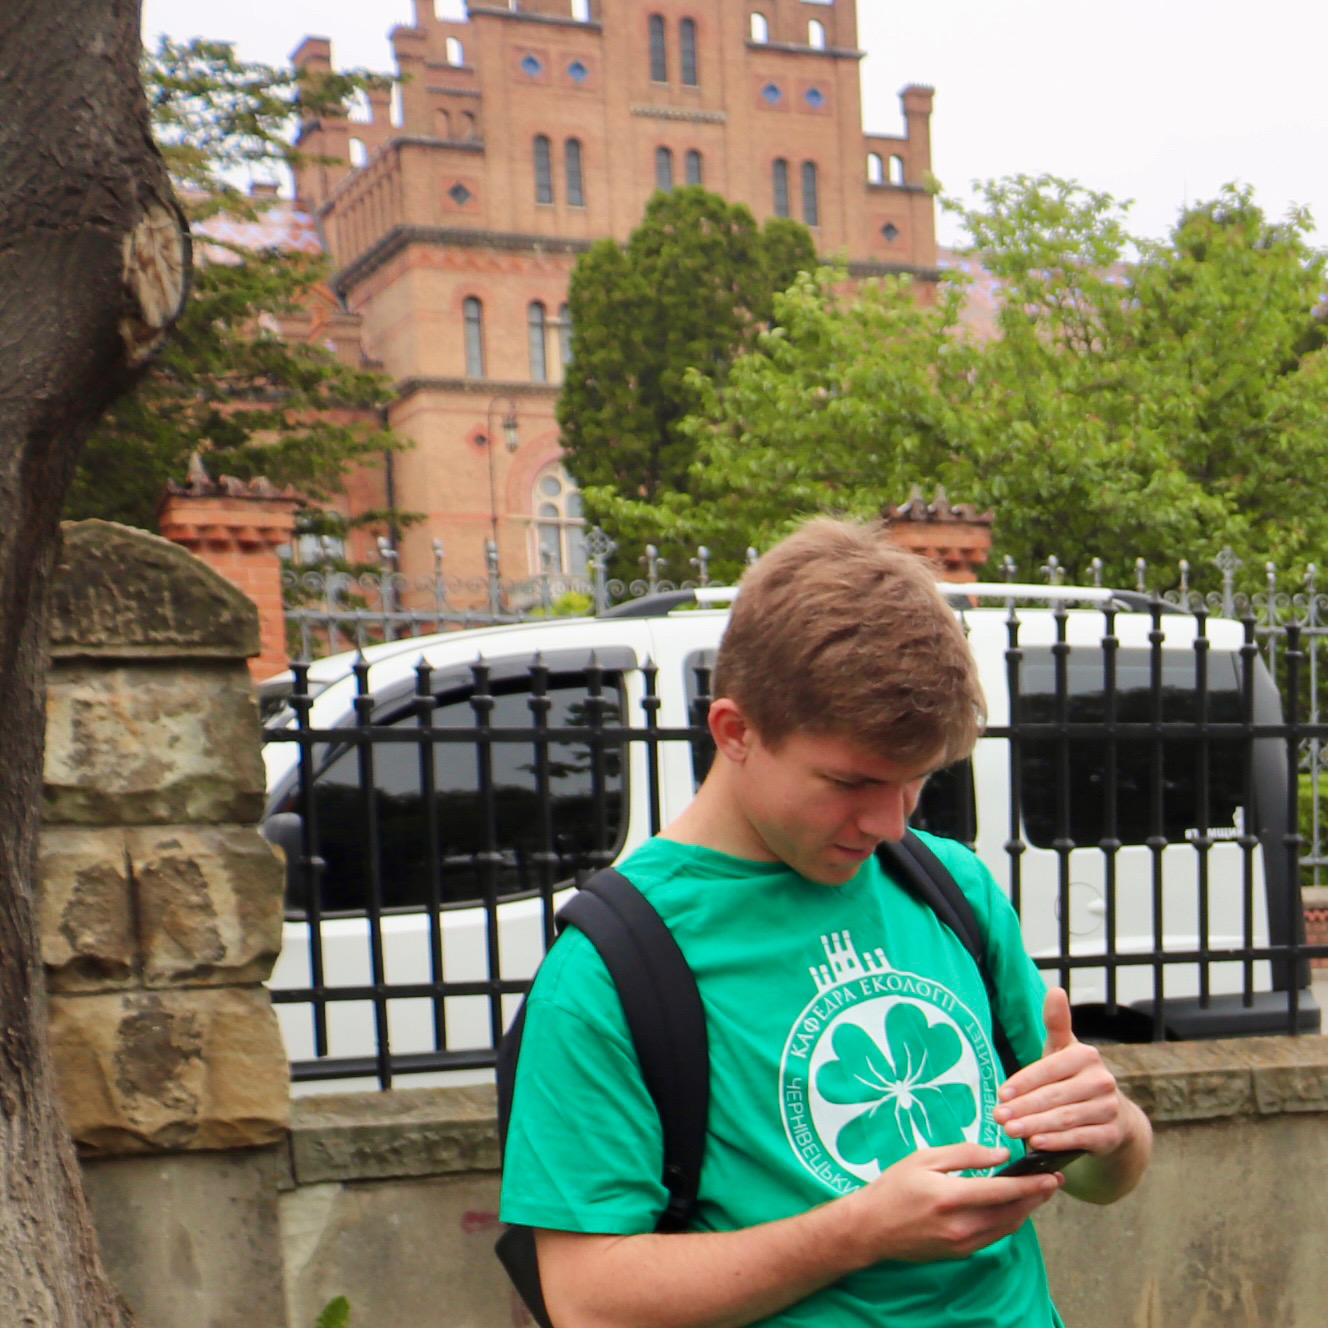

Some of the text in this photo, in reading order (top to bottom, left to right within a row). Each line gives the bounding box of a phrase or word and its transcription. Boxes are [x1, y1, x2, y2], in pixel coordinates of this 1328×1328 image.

[790, 976, 956, 1059] КАФЕДРА ЕКОЛОГІЇ
[786, 1077, 863, 1195] ЧЕРНІВЕЦЬКИ
[965, 1021, 996, 1144] УНІВЕРСИТЕТ
